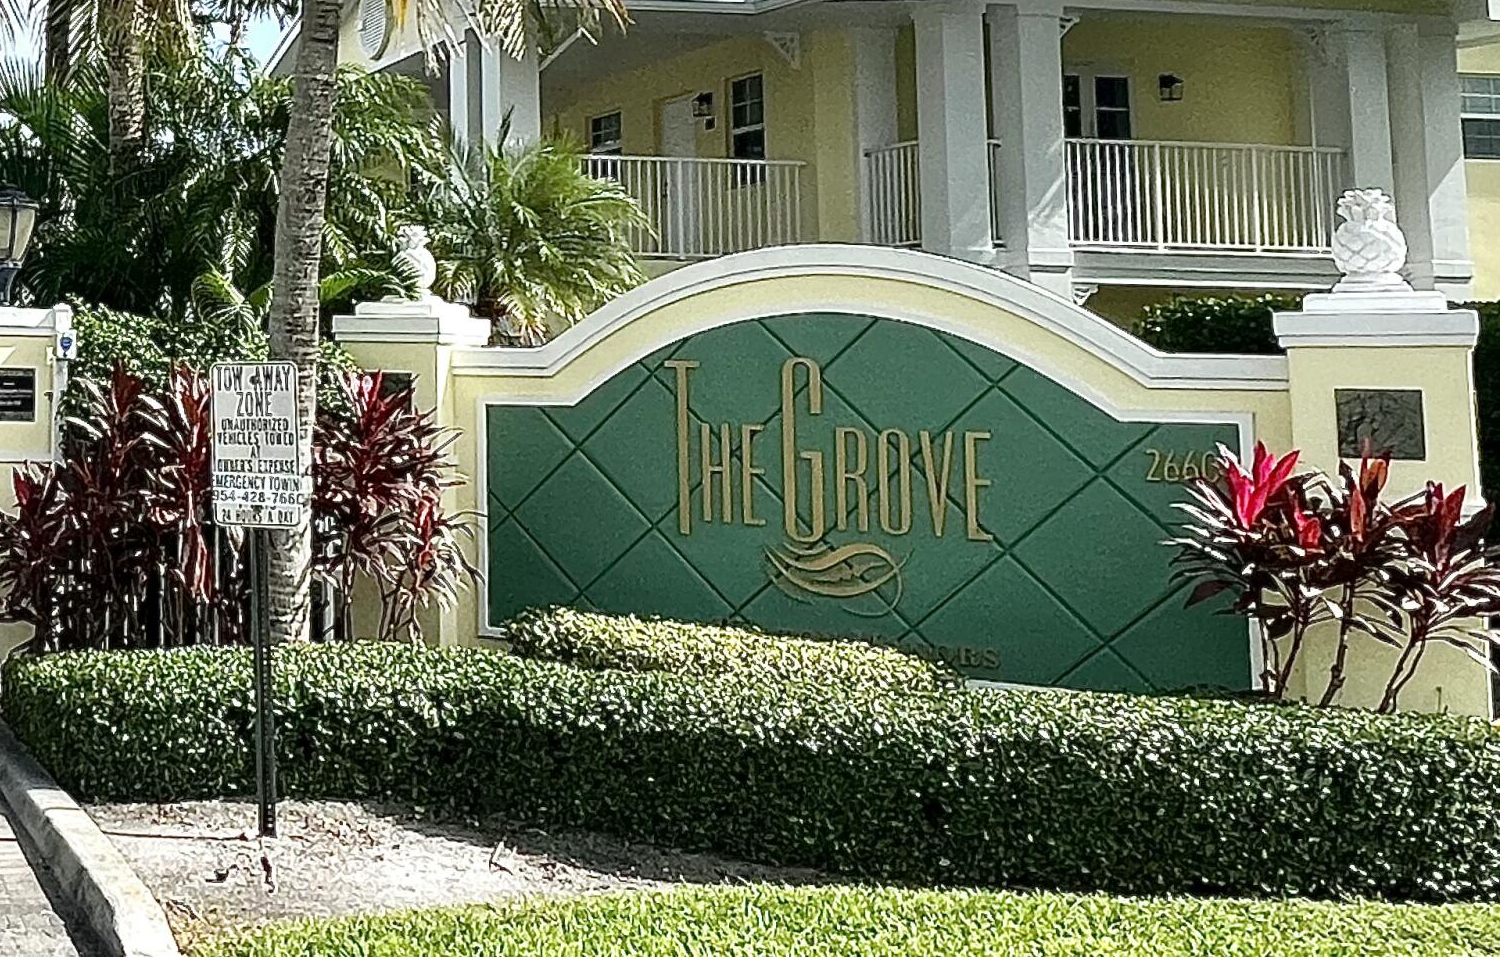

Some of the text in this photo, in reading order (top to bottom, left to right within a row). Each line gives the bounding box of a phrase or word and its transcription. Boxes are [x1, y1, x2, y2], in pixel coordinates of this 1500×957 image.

[215, 365, 291, 392] TOW AWAY
[236, 391, 273, 417] ZONE
[221, 418, 289, 432] UNAUTHORIZED
[217, 431, 295, 446] VEHICLES TOWED
[250, 445, 261, 459] AT
[664, 357, 994, 544] THE GROVE
[217, 459, 295, 475] OWNER'S EXPENSE
[269, 476, 303, 492] TOWIN
[222, 508, 232, 522] 24
[268, 510, 274, 523] A
[278, 510, 294, 524] DAY
